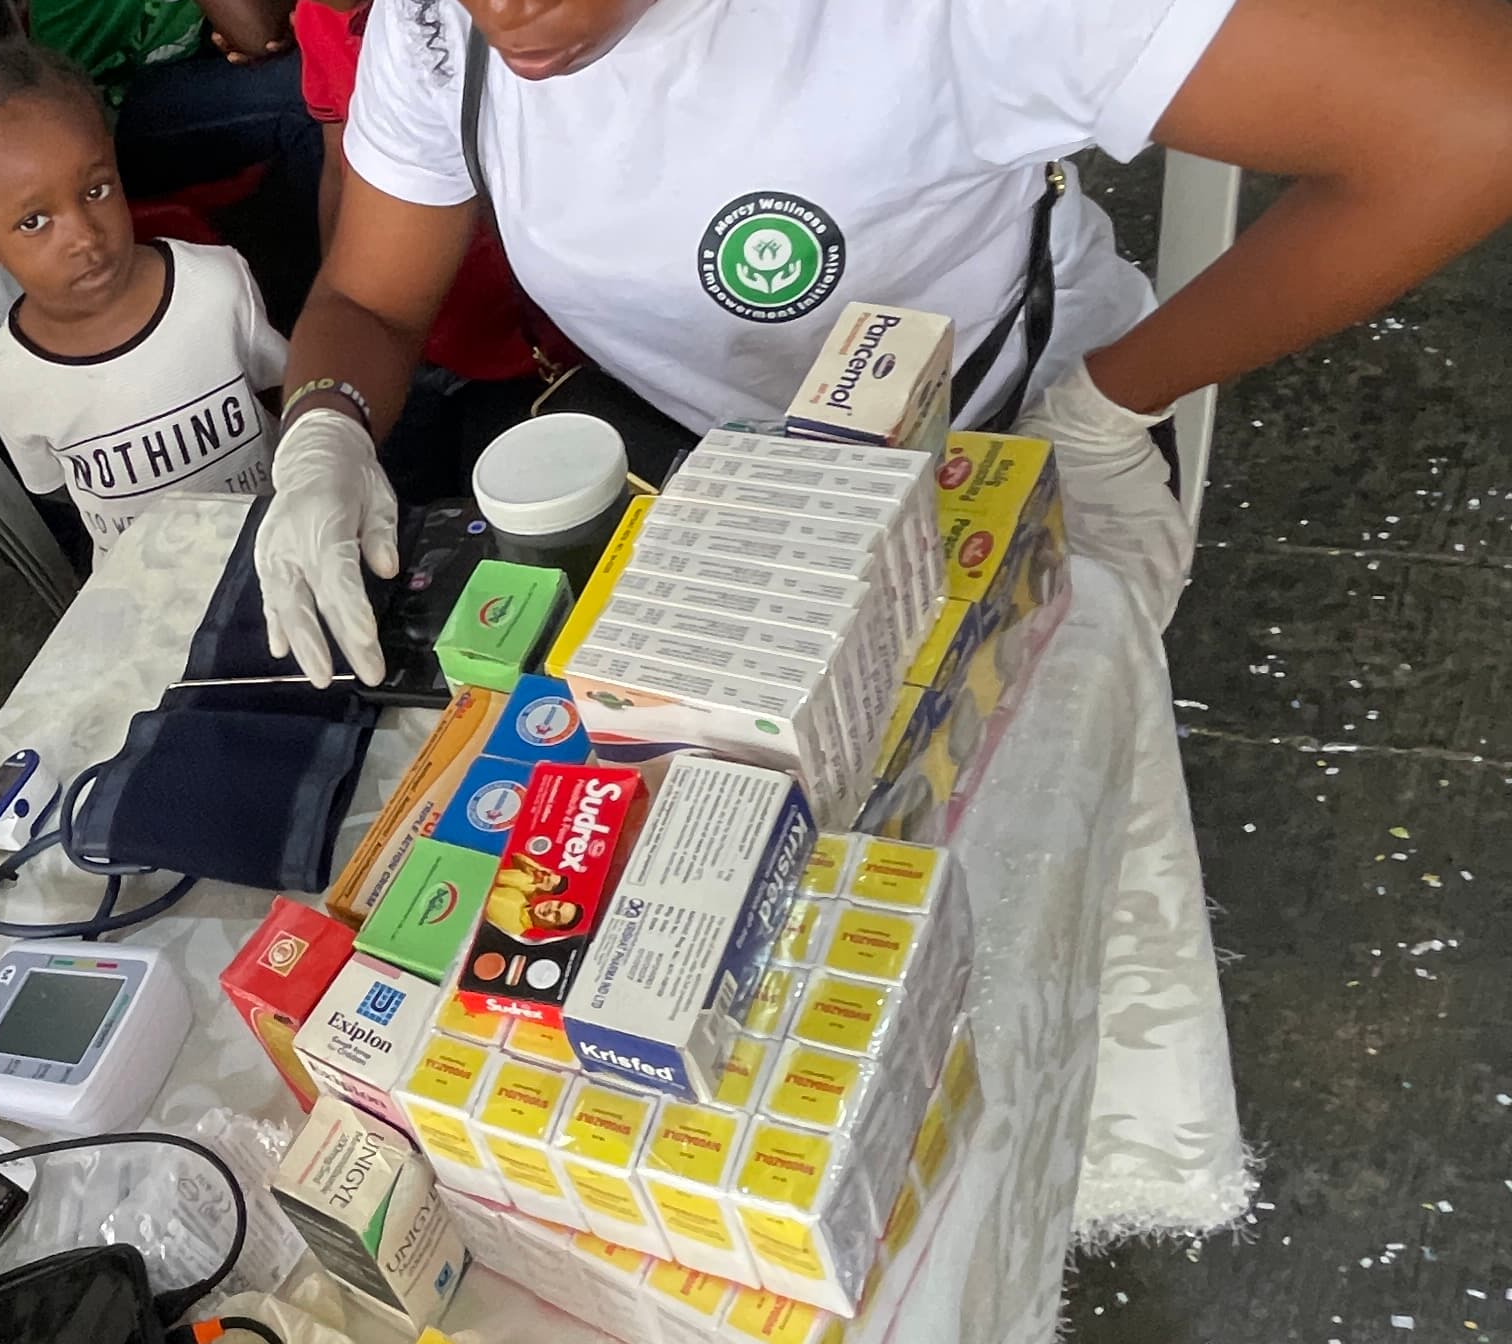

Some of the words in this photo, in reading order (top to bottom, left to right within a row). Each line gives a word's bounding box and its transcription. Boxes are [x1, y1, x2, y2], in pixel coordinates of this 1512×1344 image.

[714, 202, 756, 236] Mercy
[758, 198, 827, 235] Wellness
[702, 263, 797, 320] Empowerment
[797, 244, 839, 310] Initiative
[826, 314, 901, 414] Pancemol
[71, 396, 245, 489] NOTHING
[225, 460, 270, 494] THIS
[410, 800, 435, 833] TRIPLE
[557, 777, 623, 874] Sudrex
[387, 833, 414, 871] ACTION
[364, 870, 392, 908] CREAM
[758, 812, 808, 937] Krisfed
[602, 949, 624, 982] PHARMA
[484, 997, 546, 1022] Sudrex
[590, 994, 605, 1010] LTD
[327, 1009, 394, 1054] Exiplon
[580, 1040, 674, 1083] Krisfed
[329, 1131, 385, 1209] UNIGYL
[386, 1183, 439, 1274] UNIGYL
